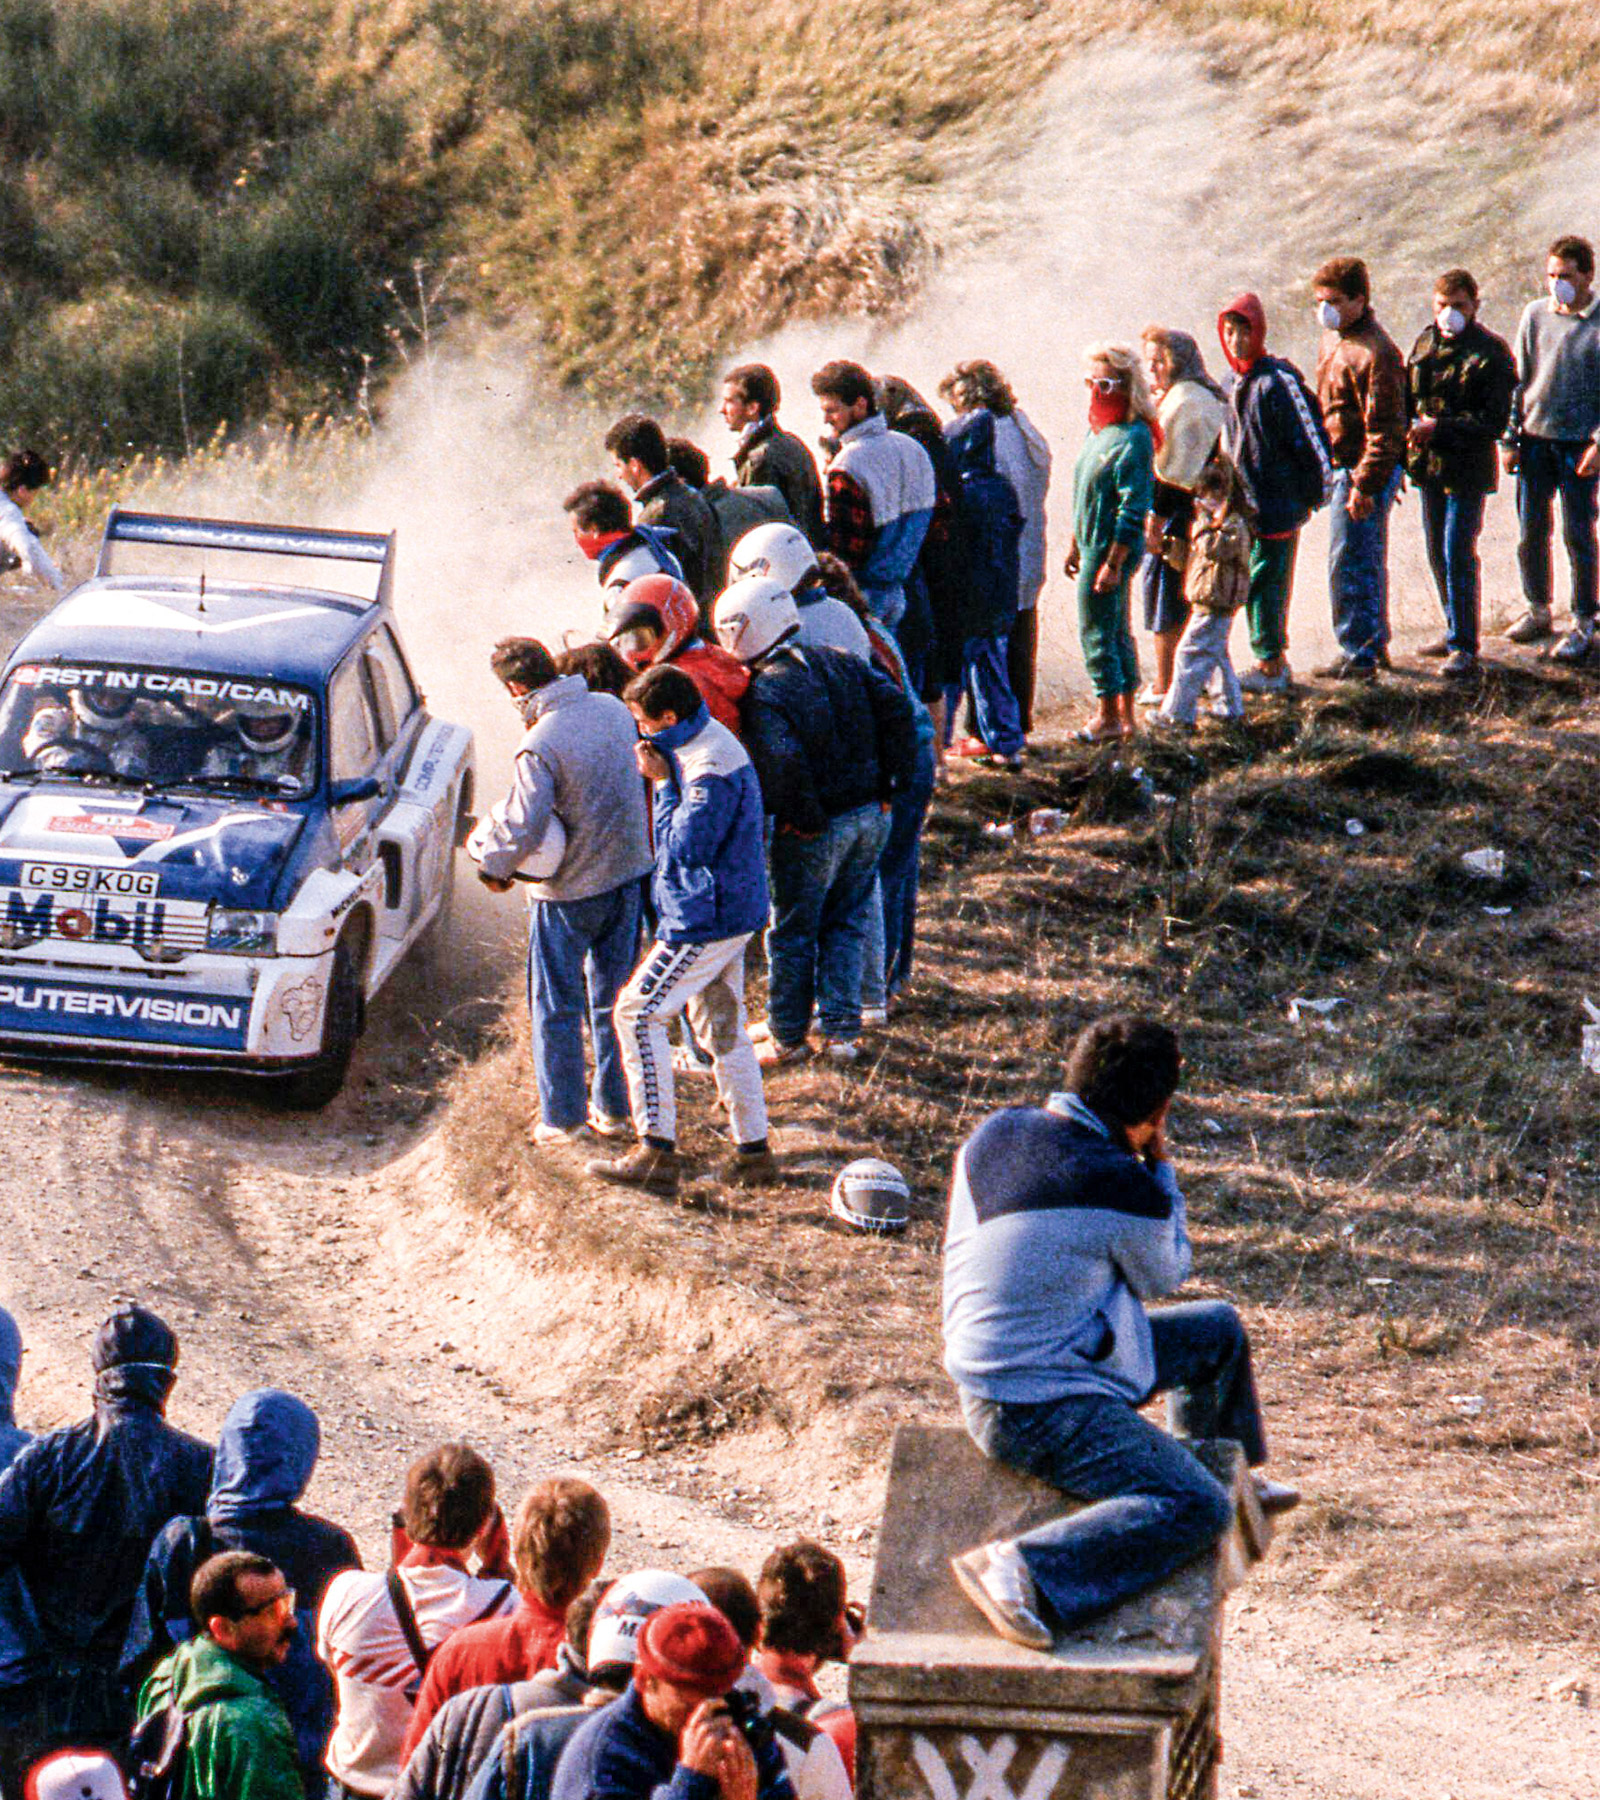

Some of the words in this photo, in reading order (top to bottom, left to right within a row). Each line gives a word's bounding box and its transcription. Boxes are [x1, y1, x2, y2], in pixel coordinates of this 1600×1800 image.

[37, 667, 100, 686] RST
[105, 670, 140, 689] IN
[144, 673, 310, 710] CAD/CAM
[5, 891, 167, 946] Mobil
